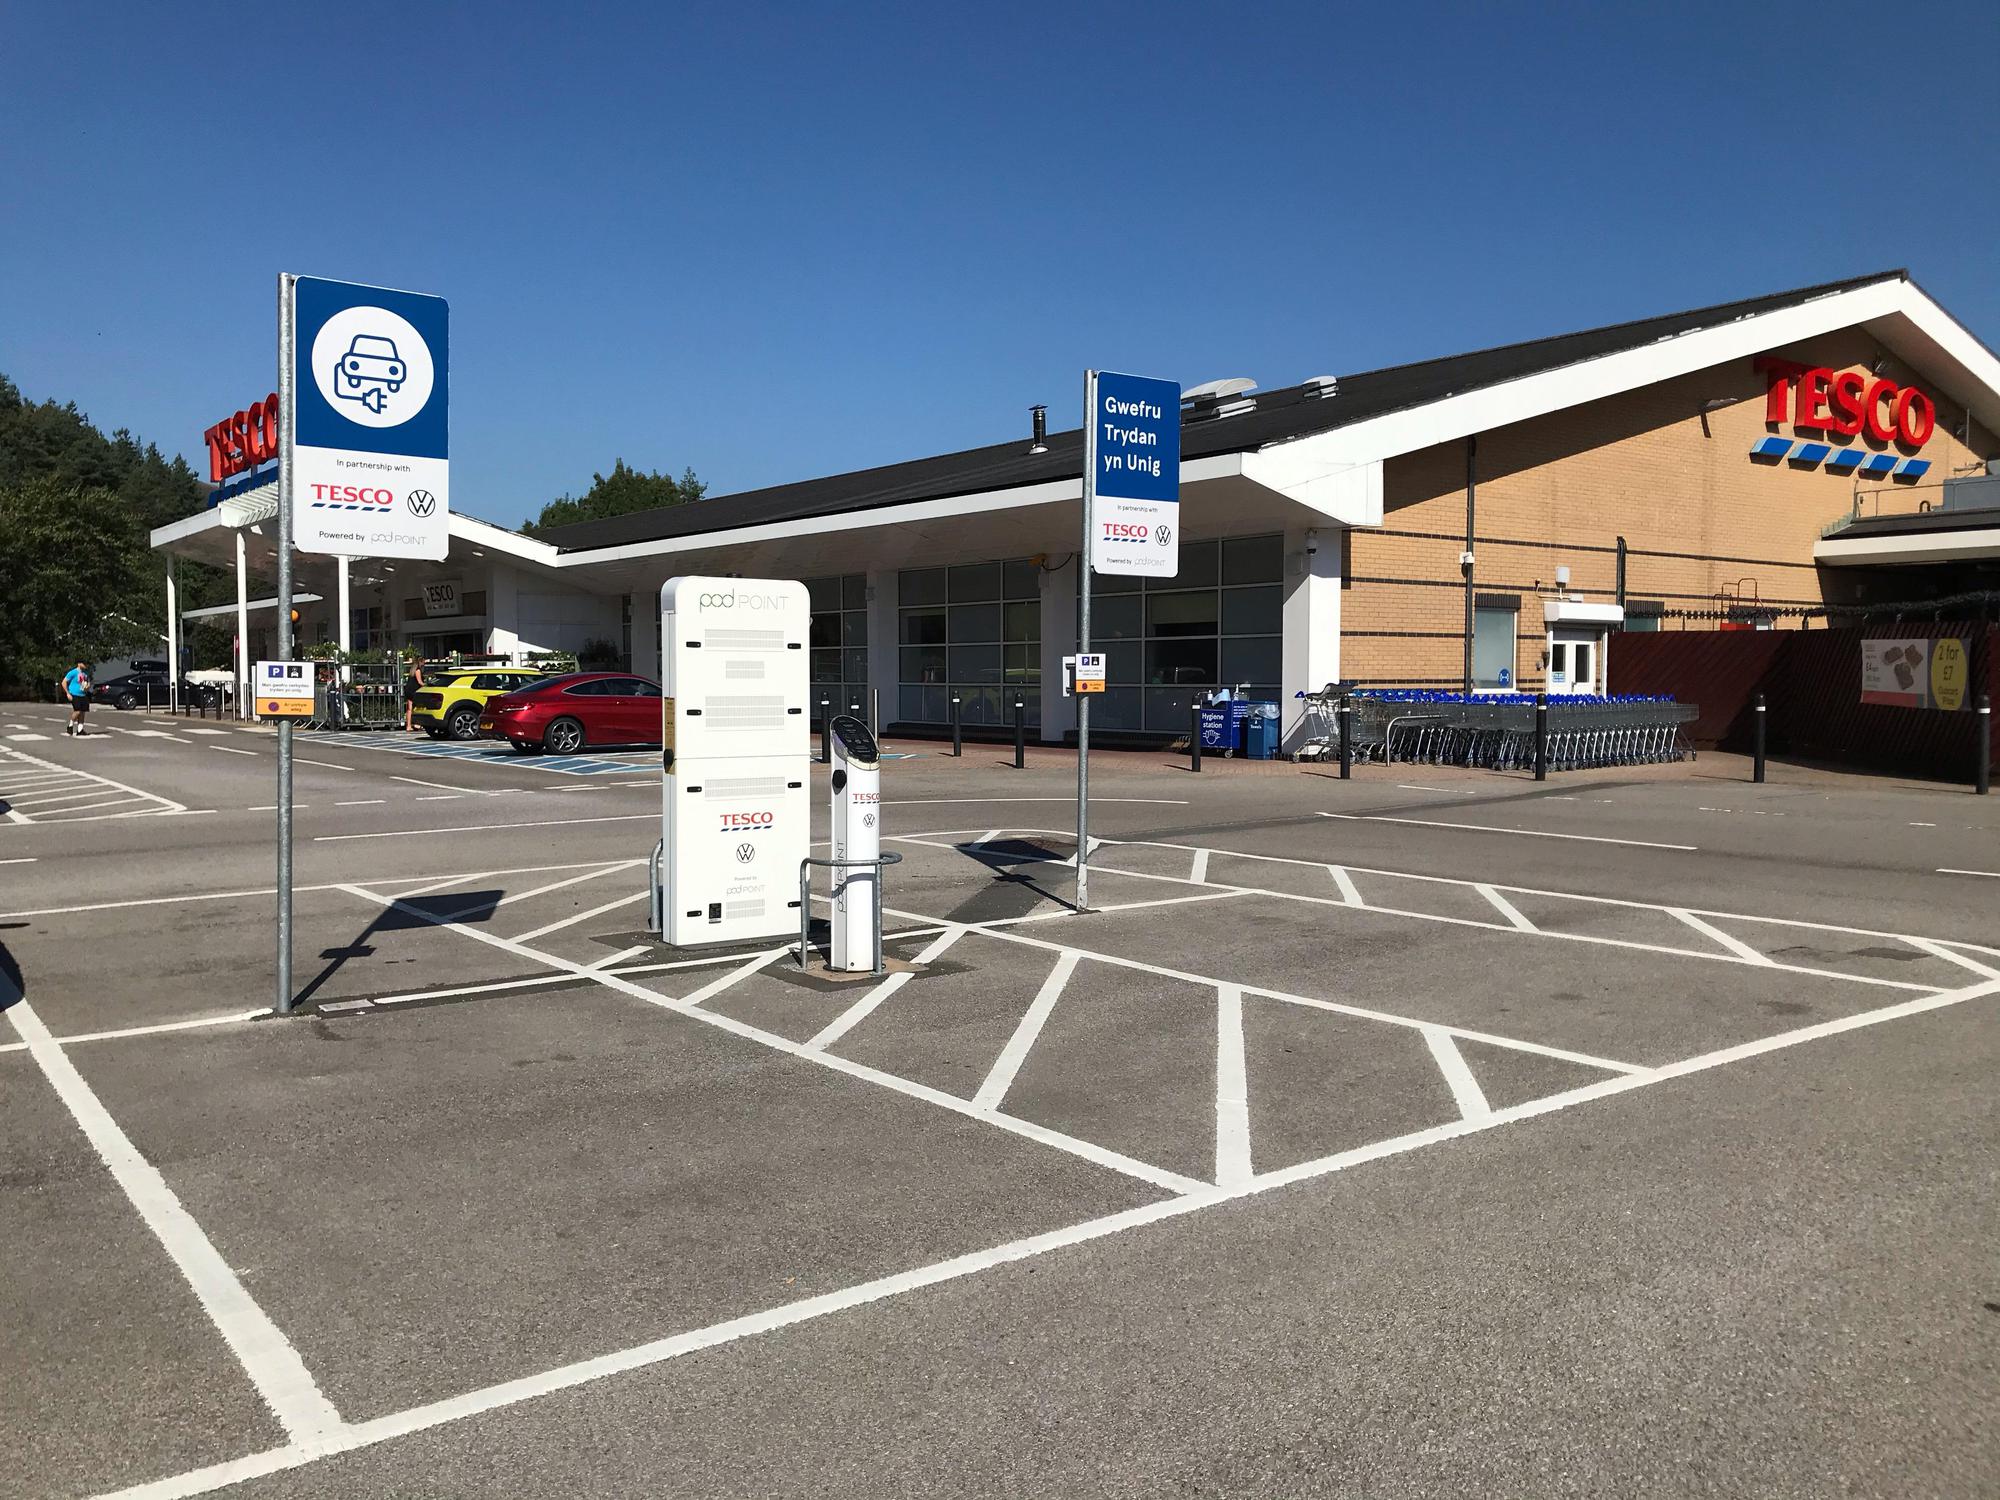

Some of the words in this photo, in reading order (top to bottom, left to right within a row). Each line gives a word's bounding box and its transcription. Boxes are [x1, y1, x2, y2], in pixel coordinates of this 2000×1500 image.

[1105, 396, 1161, 419] Gwefru
[1753, 357, 1936, 447] TESCO
[204, 392, 279, 483] TESCO
[1104, 423, 1157, 447] Trydan
[336, 459, 344, 467] In
[346, 460, 393, 471] partnership
[394, 463, 411, 473] with
[1104, 454, 1122, 473] yn
[1127, 453, 1161, 477] Unig
[310, 483, 394, 505] TESCO
[319, 530, 354, 541] Powered
[355, 532, 365, 542] by
[394, 534, 427, 546] POINT
[1103, 523, 1148, 538] TESCO
[699, 587, 735, 614] pod
[738, 594, 790, 611] POINT
[1945, 644, 1959, 661] for
[1202, 713, 1225, 721] Hygiene
[852, 792, 881, 801] TESCO
[719, 812, 773, 826] TESCO
